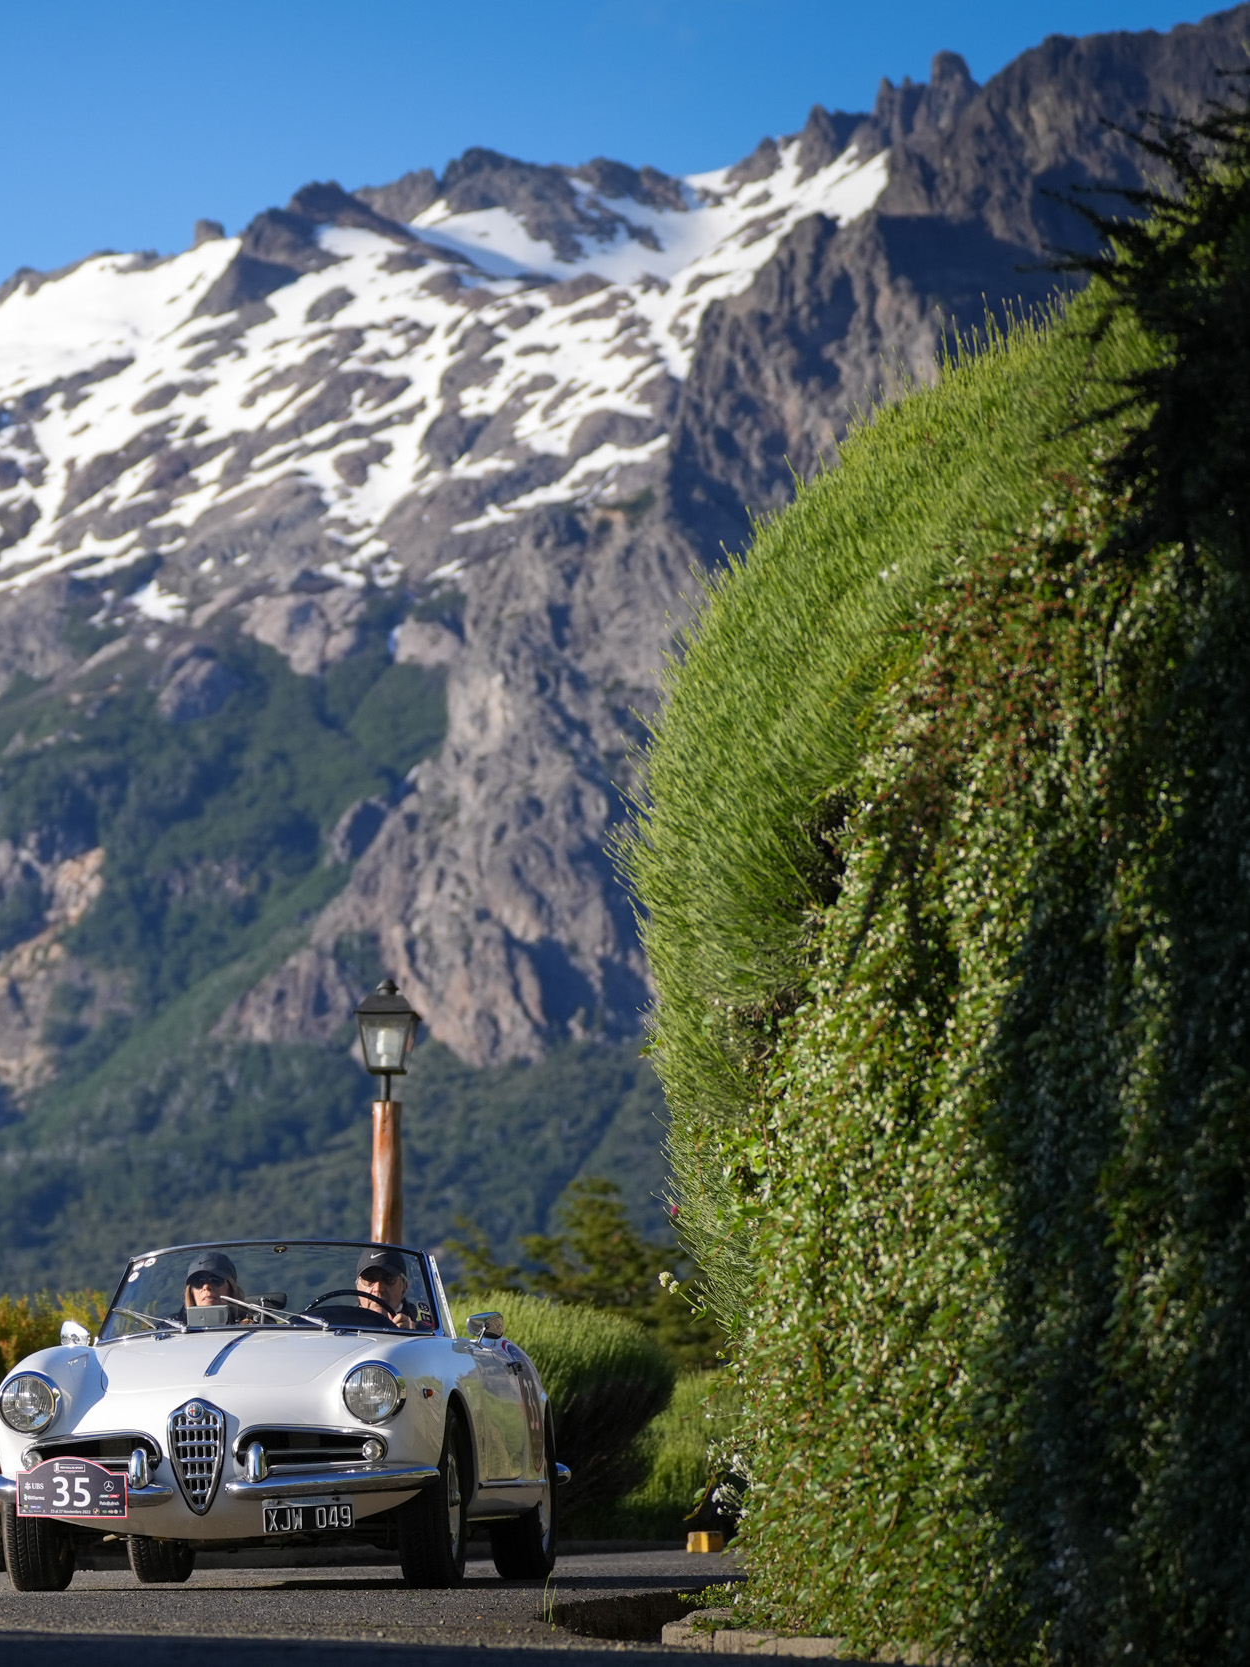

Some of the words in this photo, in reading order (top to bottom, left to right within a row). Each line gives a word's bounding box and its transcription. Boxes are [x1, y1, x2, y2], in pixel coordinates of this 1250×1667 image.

[31, 1482, 44, 1490] UBS
[52, 1476, 91, 1507] 35
[266, 1507, 303, 1532] XJW
[315, 1505, 351, 1529] 049
